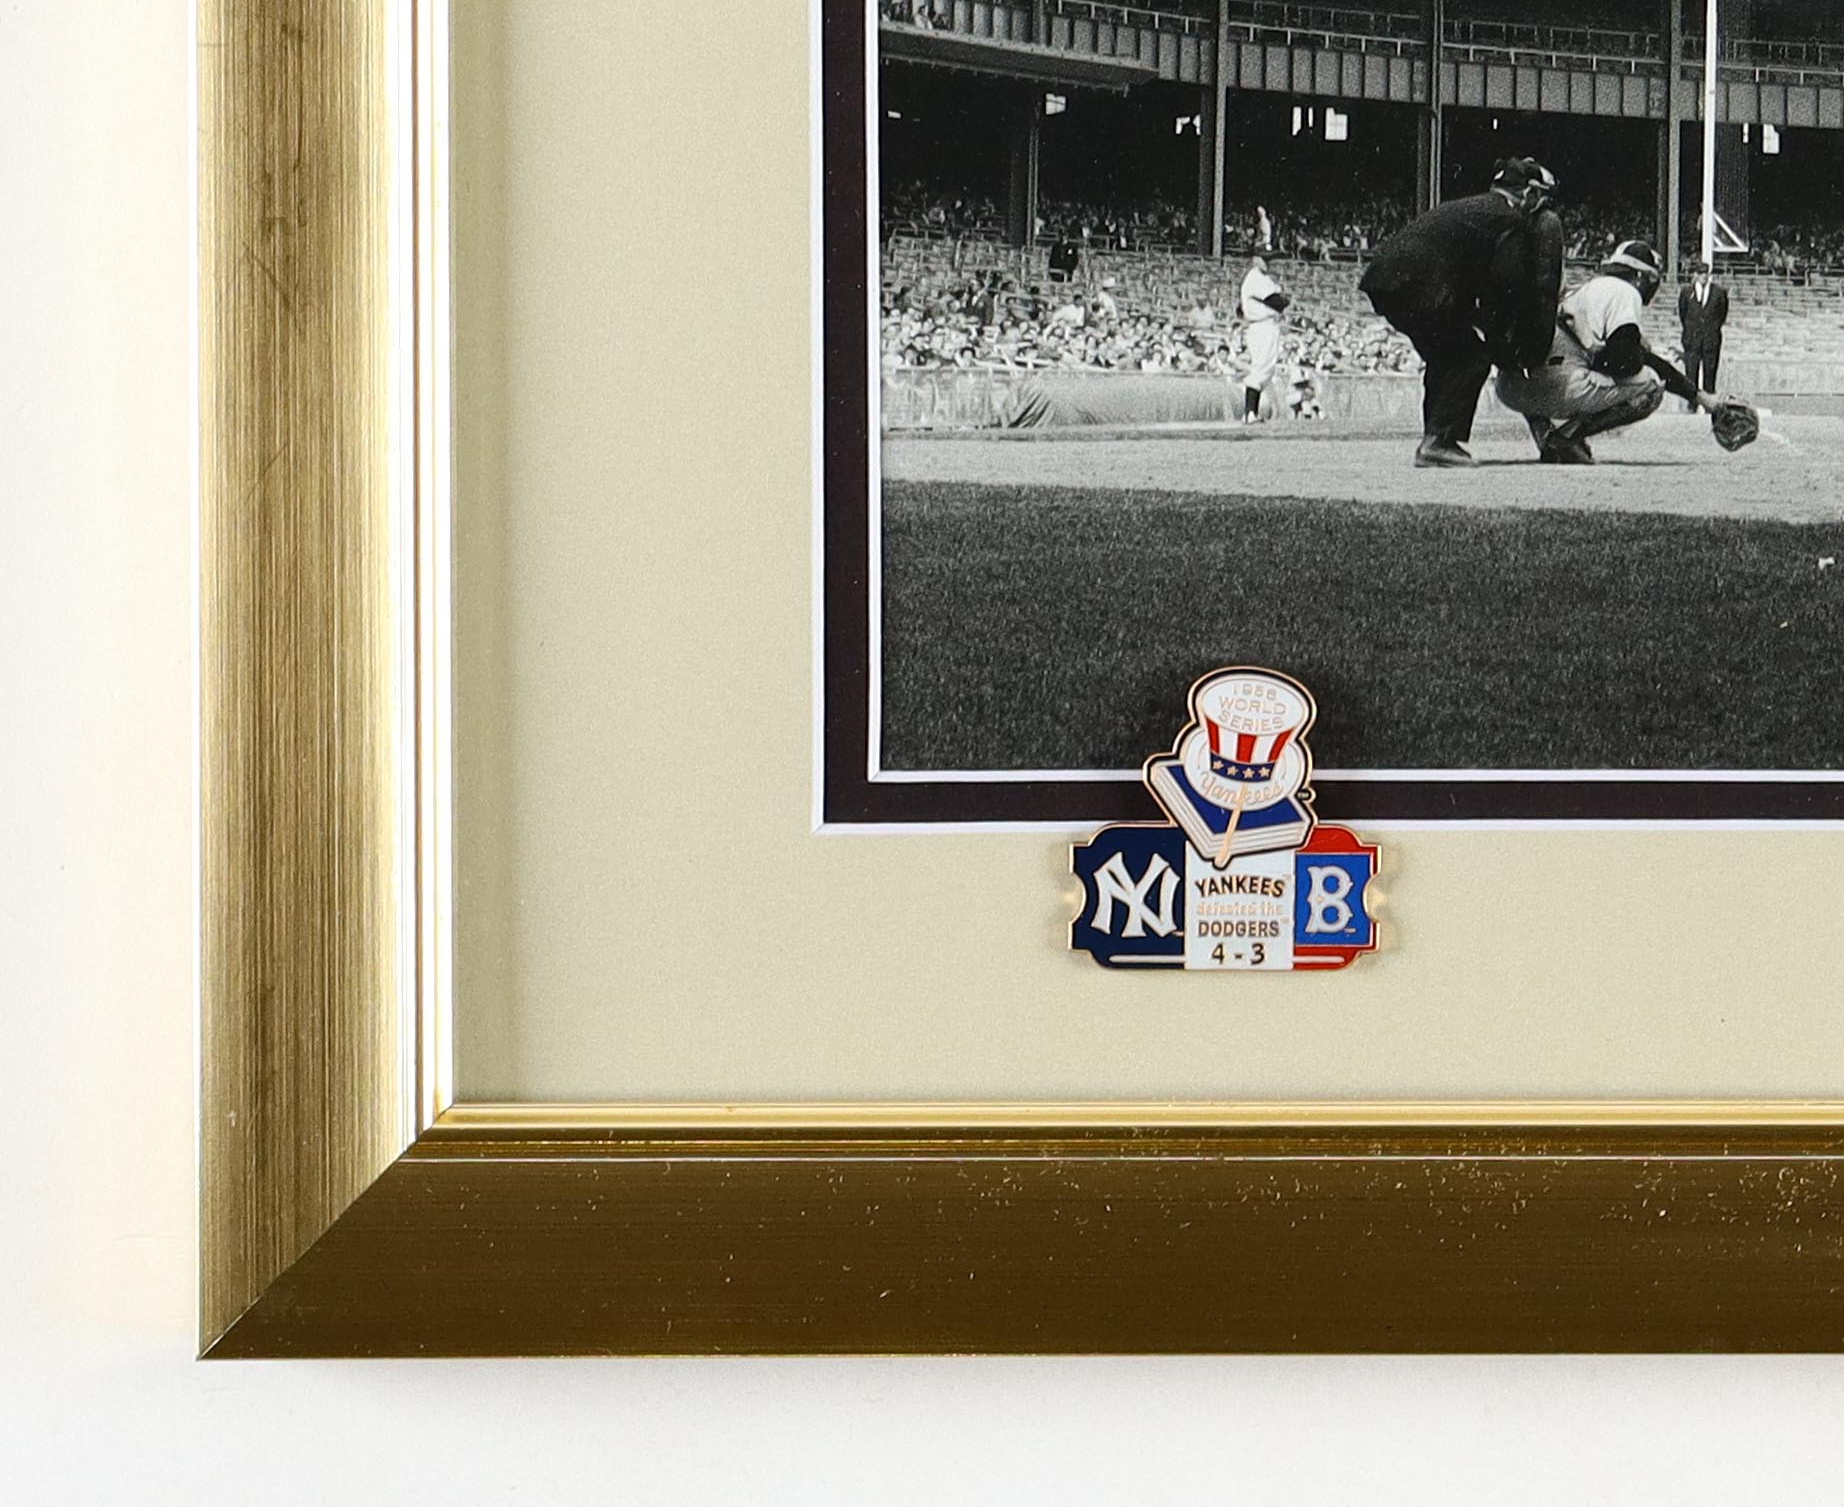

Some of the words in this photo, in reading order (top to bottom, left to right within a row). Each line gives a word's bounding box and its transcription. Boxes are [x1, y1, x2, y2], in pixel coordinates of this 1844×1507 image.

[1219, 696, 1287, 715] WORLD
[1218, 710, 1284, 732] SERIES
[1194, 875, 1285, 898] YANKEES
[1305, 865, 1354, 933] B
[1197, 920, 1280, 938] DODGERS
